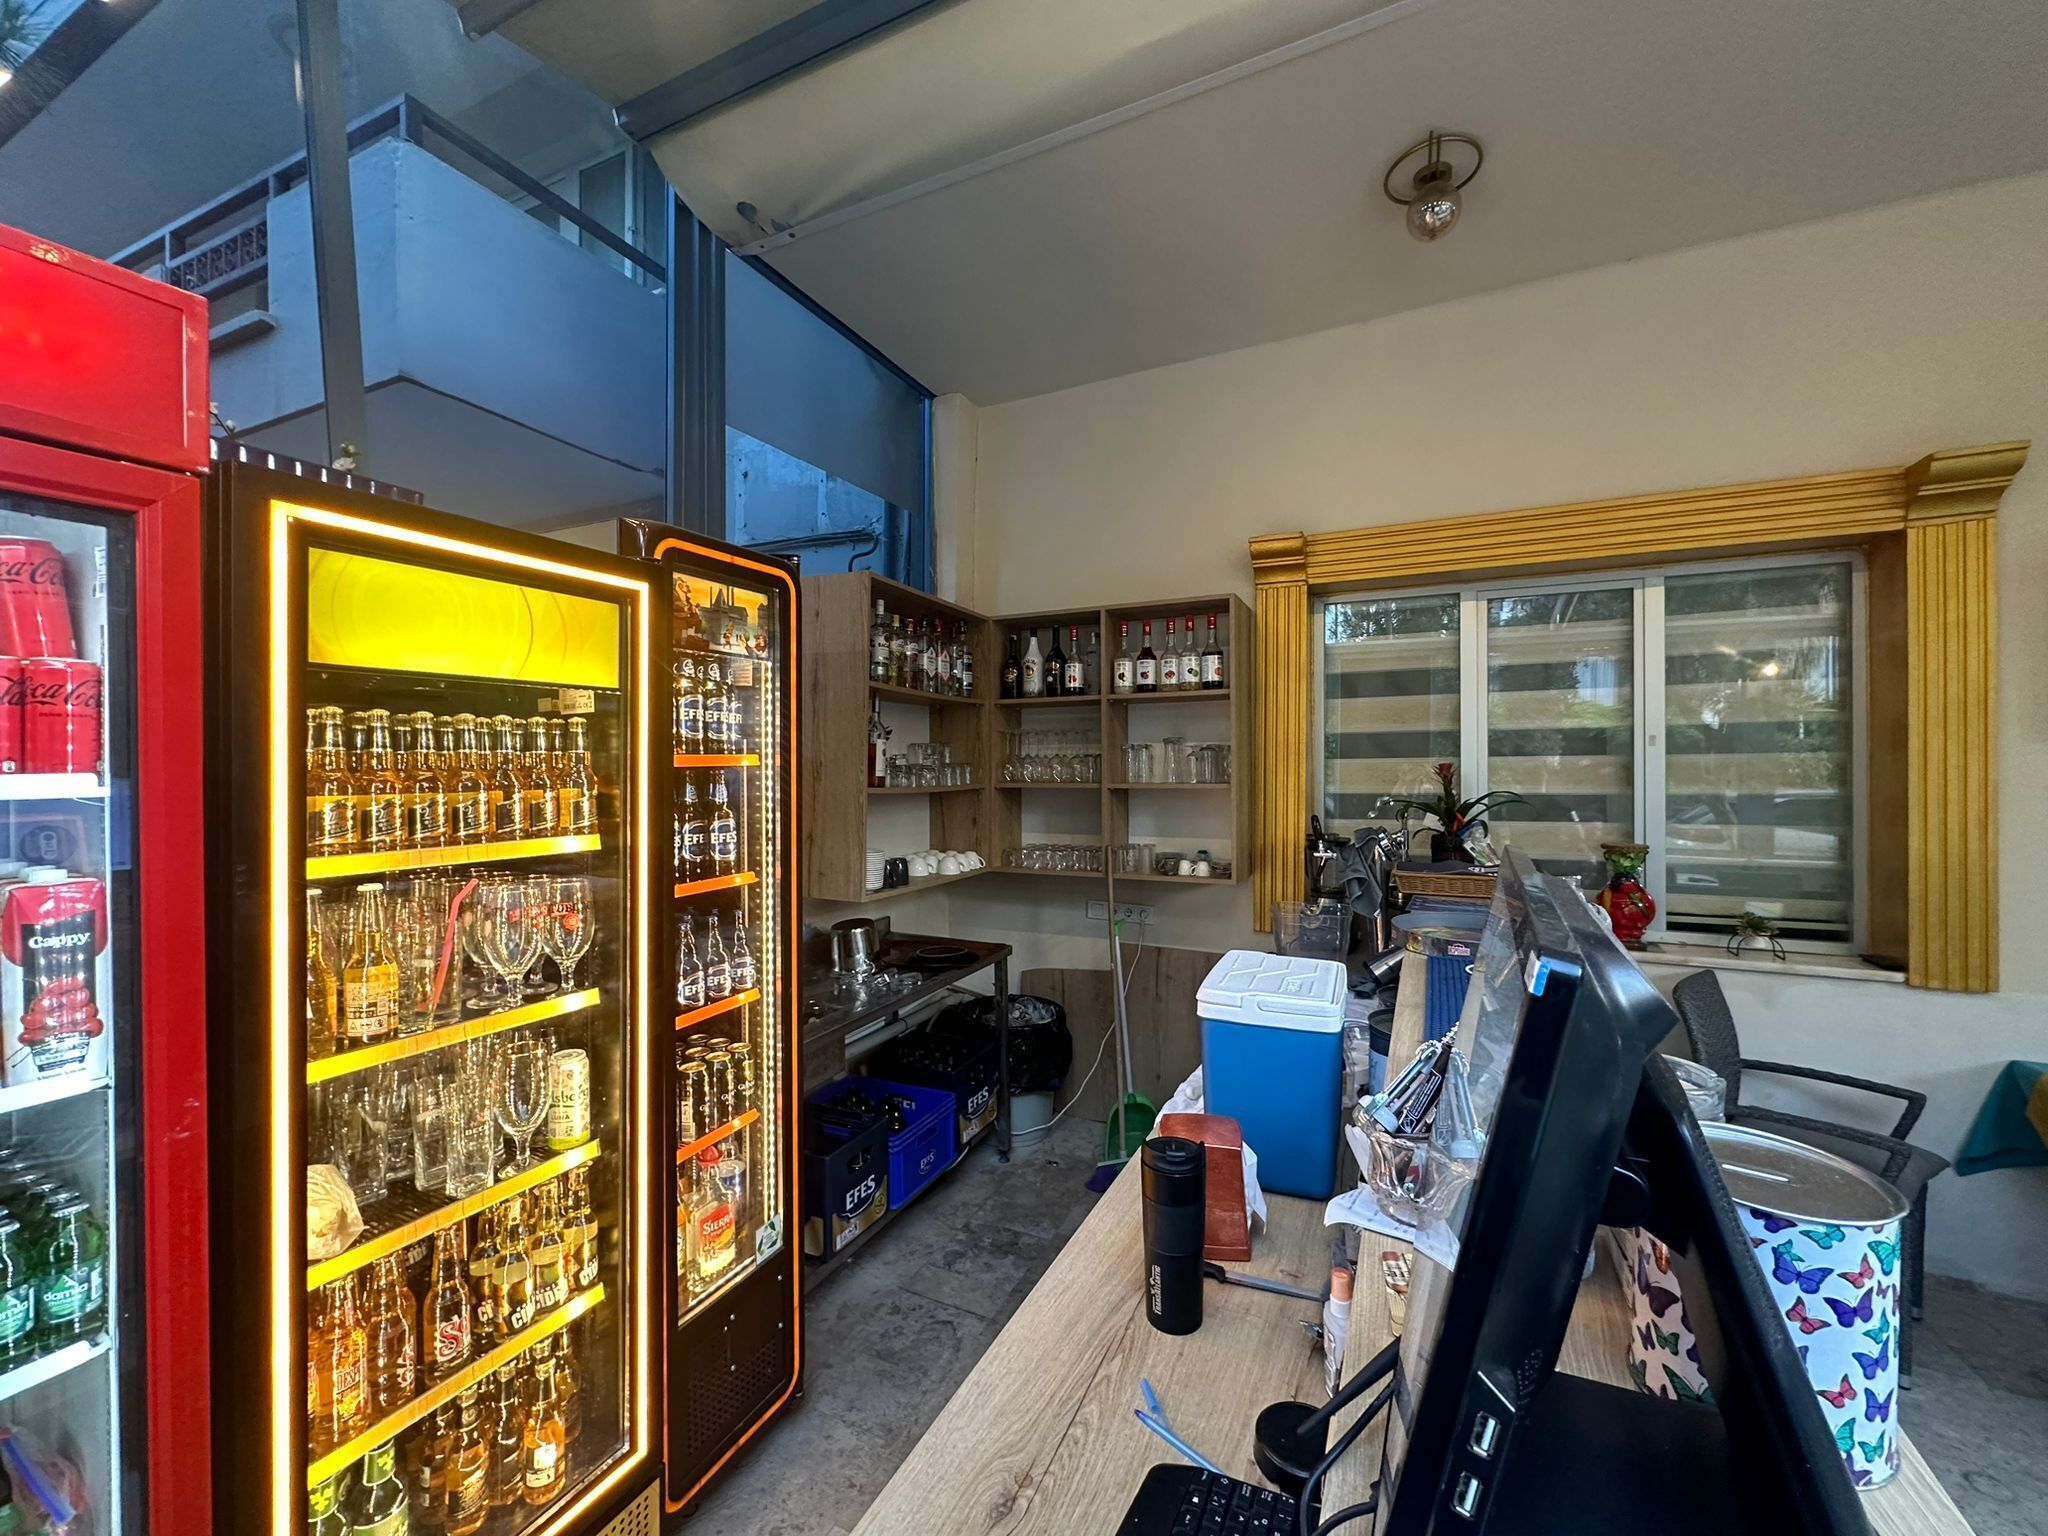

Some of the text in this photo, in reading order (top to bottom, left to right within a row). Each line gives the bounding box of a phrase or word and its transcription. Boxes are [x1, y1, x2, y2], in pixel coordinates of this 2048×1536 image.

[711, 831, 737, 844] EFES
[28, 932, 91, 948] Cappy
[968, 1086, 989, 1113] EFES
[846, 1174, 875, 1211] EFES
[43, 1283, 88, 1301] damla
